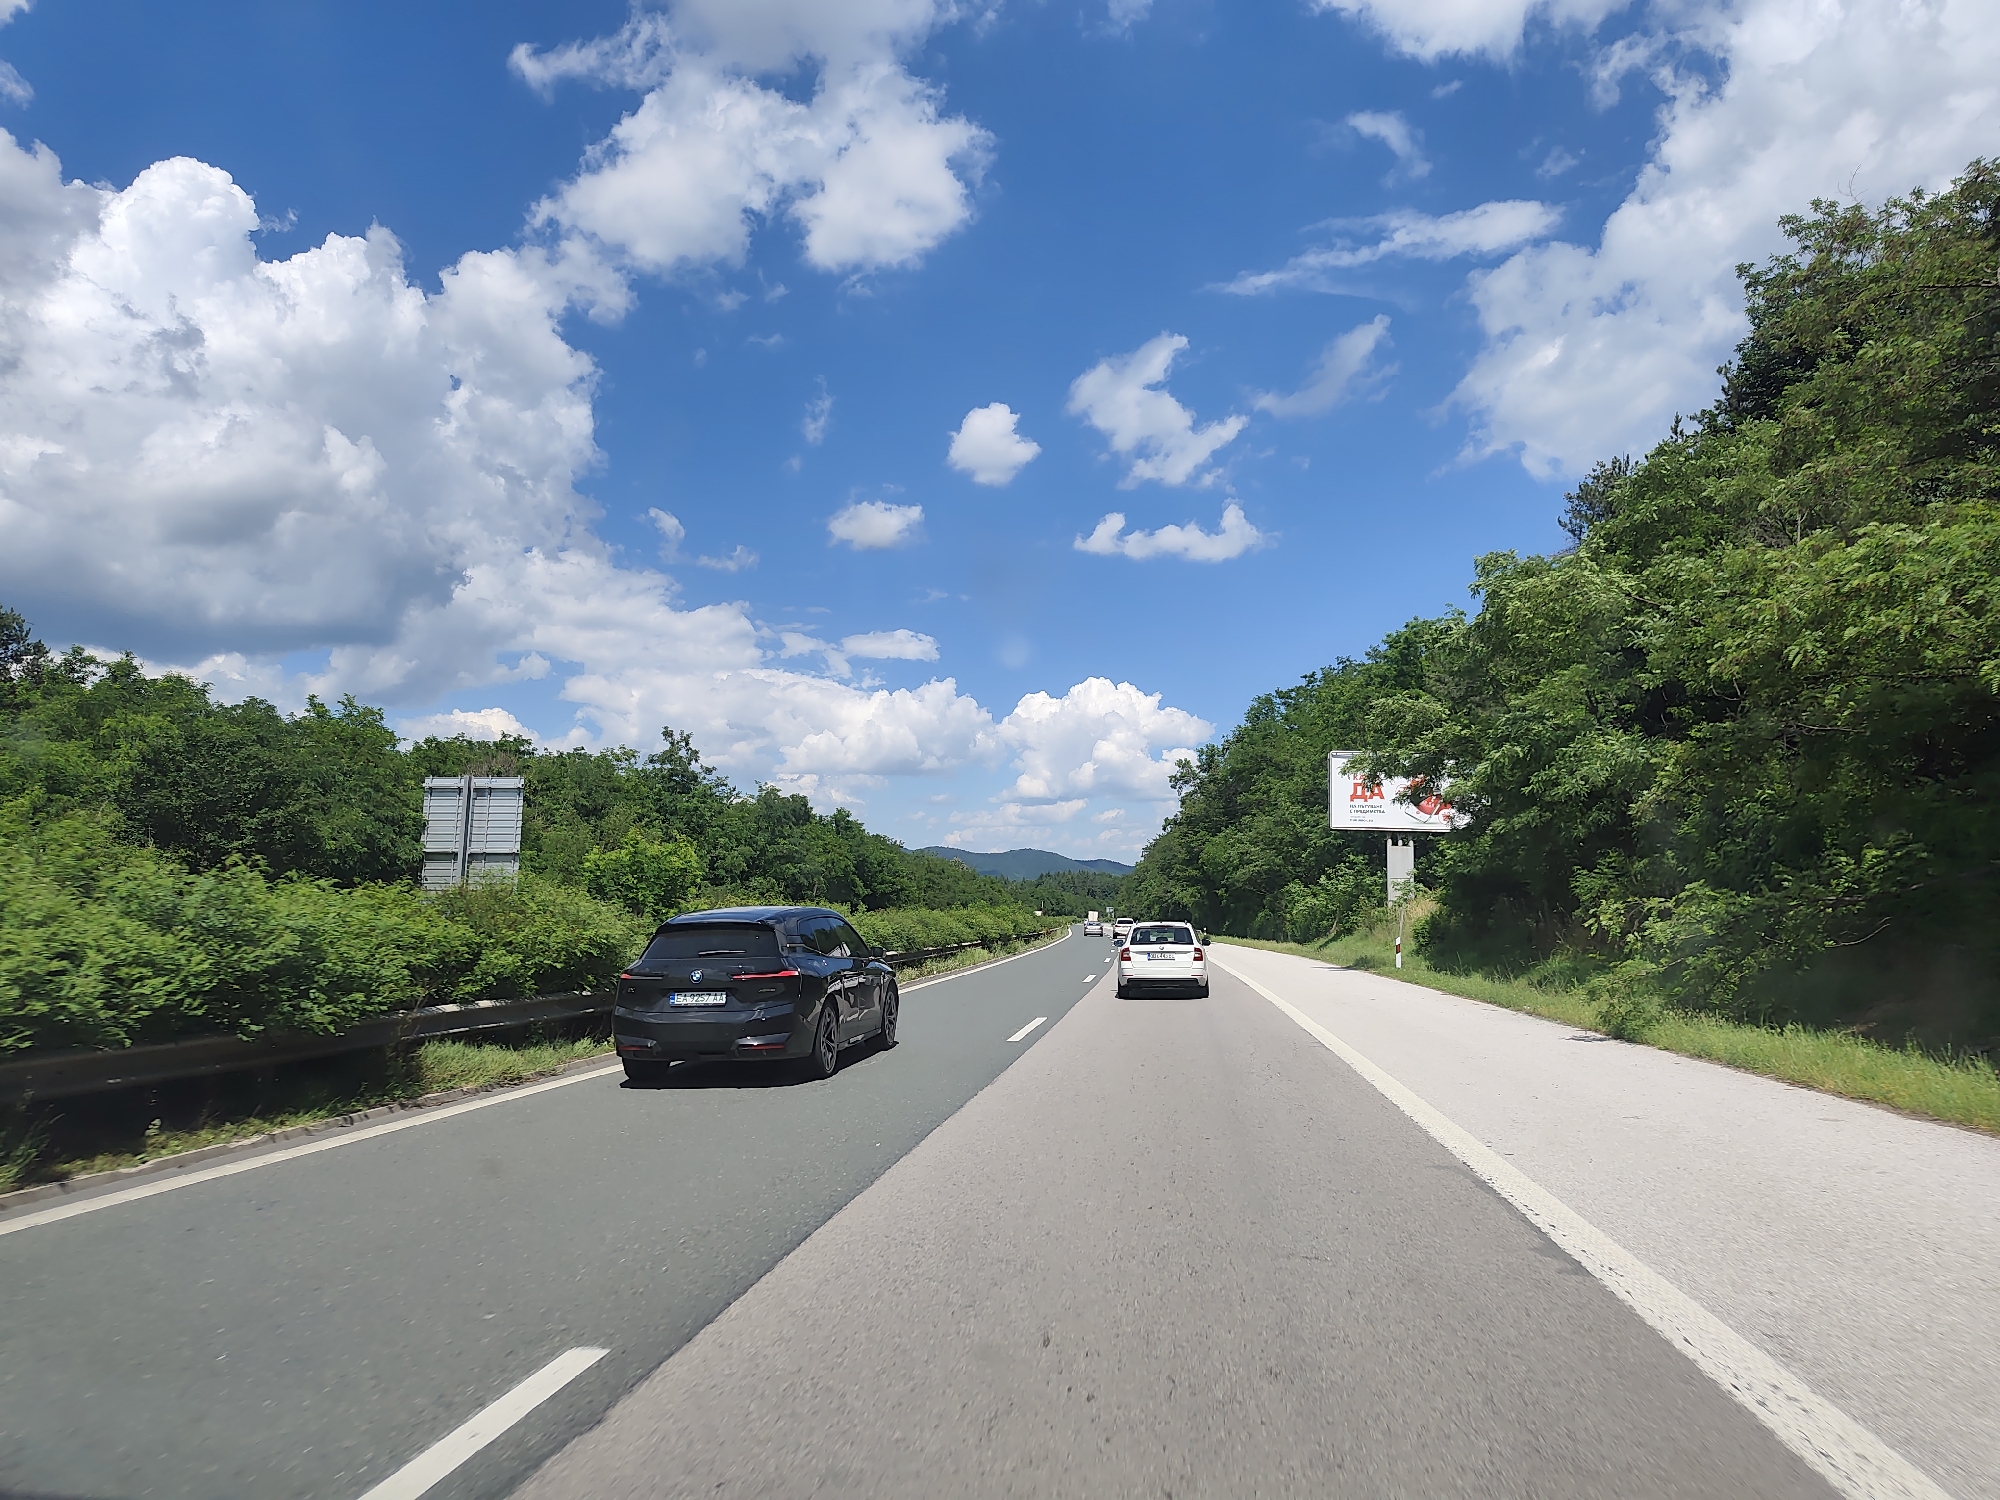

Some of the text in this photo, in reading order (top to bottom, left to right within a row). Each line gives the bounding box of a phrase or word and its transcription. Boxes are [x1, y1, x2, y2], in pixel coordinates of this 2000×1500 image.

[1350, 782, 1385, 802] ДА
[676, 992, 724, 1003] EA 9257 AA
